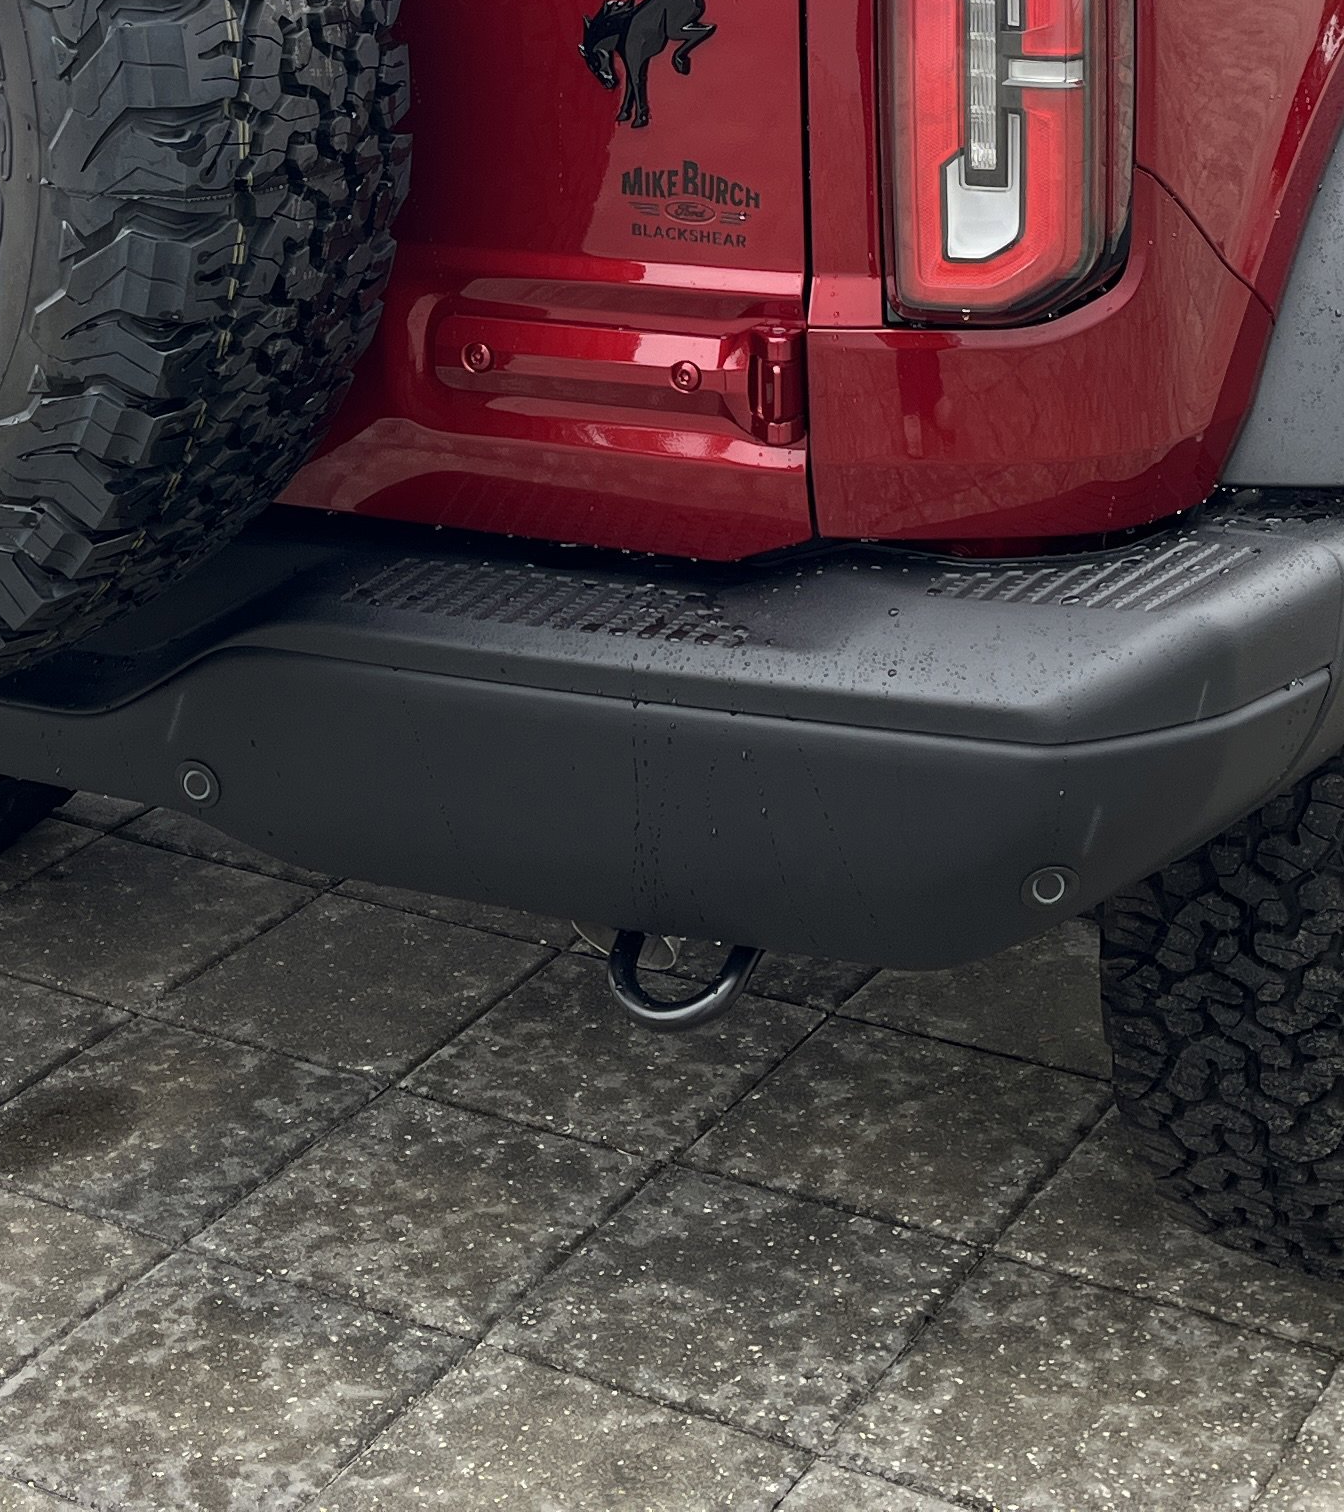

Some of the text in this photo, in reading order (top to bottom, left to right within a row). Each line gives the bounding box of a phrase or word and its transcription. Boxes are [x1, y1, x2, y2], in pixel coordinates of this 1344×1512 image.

[621, 159, 761, 209] MIKE BURCH
[631, 223, 747, 248] BLACKSHEAR
